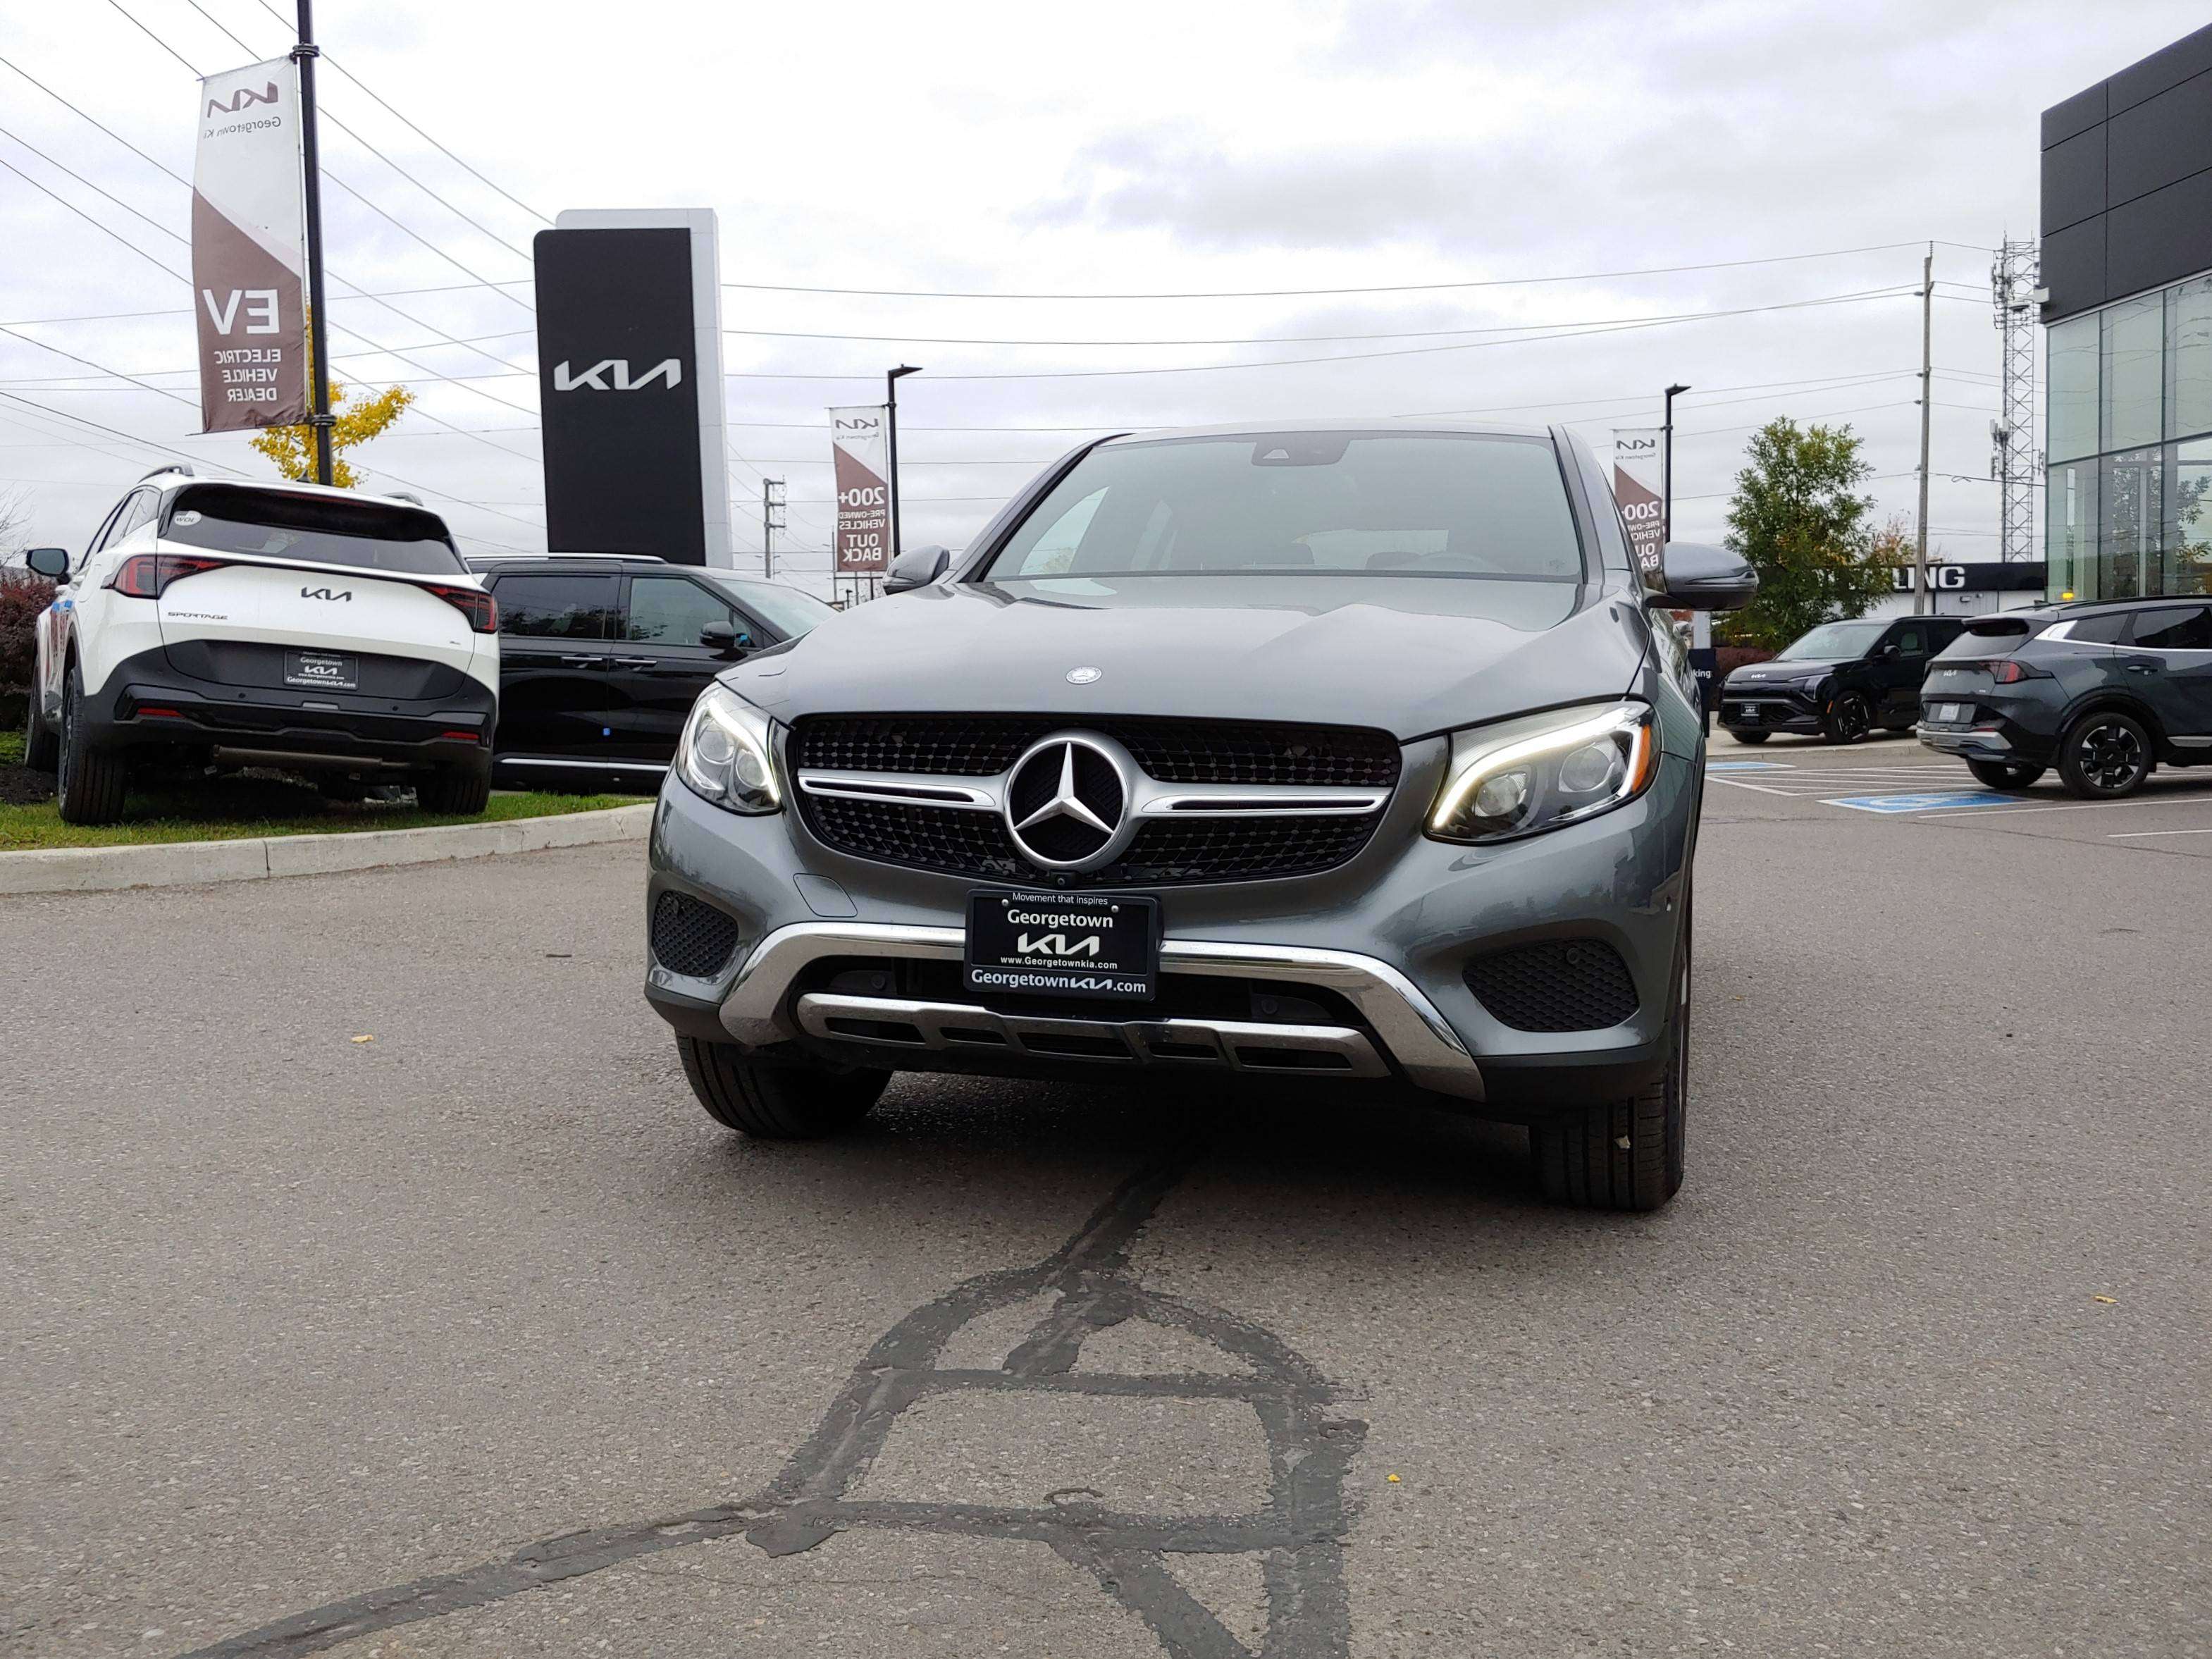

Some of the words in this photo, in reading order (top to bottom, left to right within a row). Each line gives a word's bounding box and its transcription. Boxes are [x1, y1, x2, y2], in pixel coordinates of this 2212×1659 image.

[554, 358, 682, 391] KIA
[1892, 566, 1965, 588] LING
[301, 587, 352, 602] KIA
[168, 611, 228, 620] SPORTAGE
[300, 656, 342, 666] Georgetown
[304, 665, 338, 675] KIA
[1692, 669, 1711, 679] king
[1012, 892, 1056, 903] Movement
[1058, 895, 1075, 903] that
[1076, 896, 1108, 906] inspires
[1007, 909, 1113, 928] Georgetown
[1018, 932, 1100, 956] KIA
[1001, 956, 1118, 970] www.Georgetownkia.com
